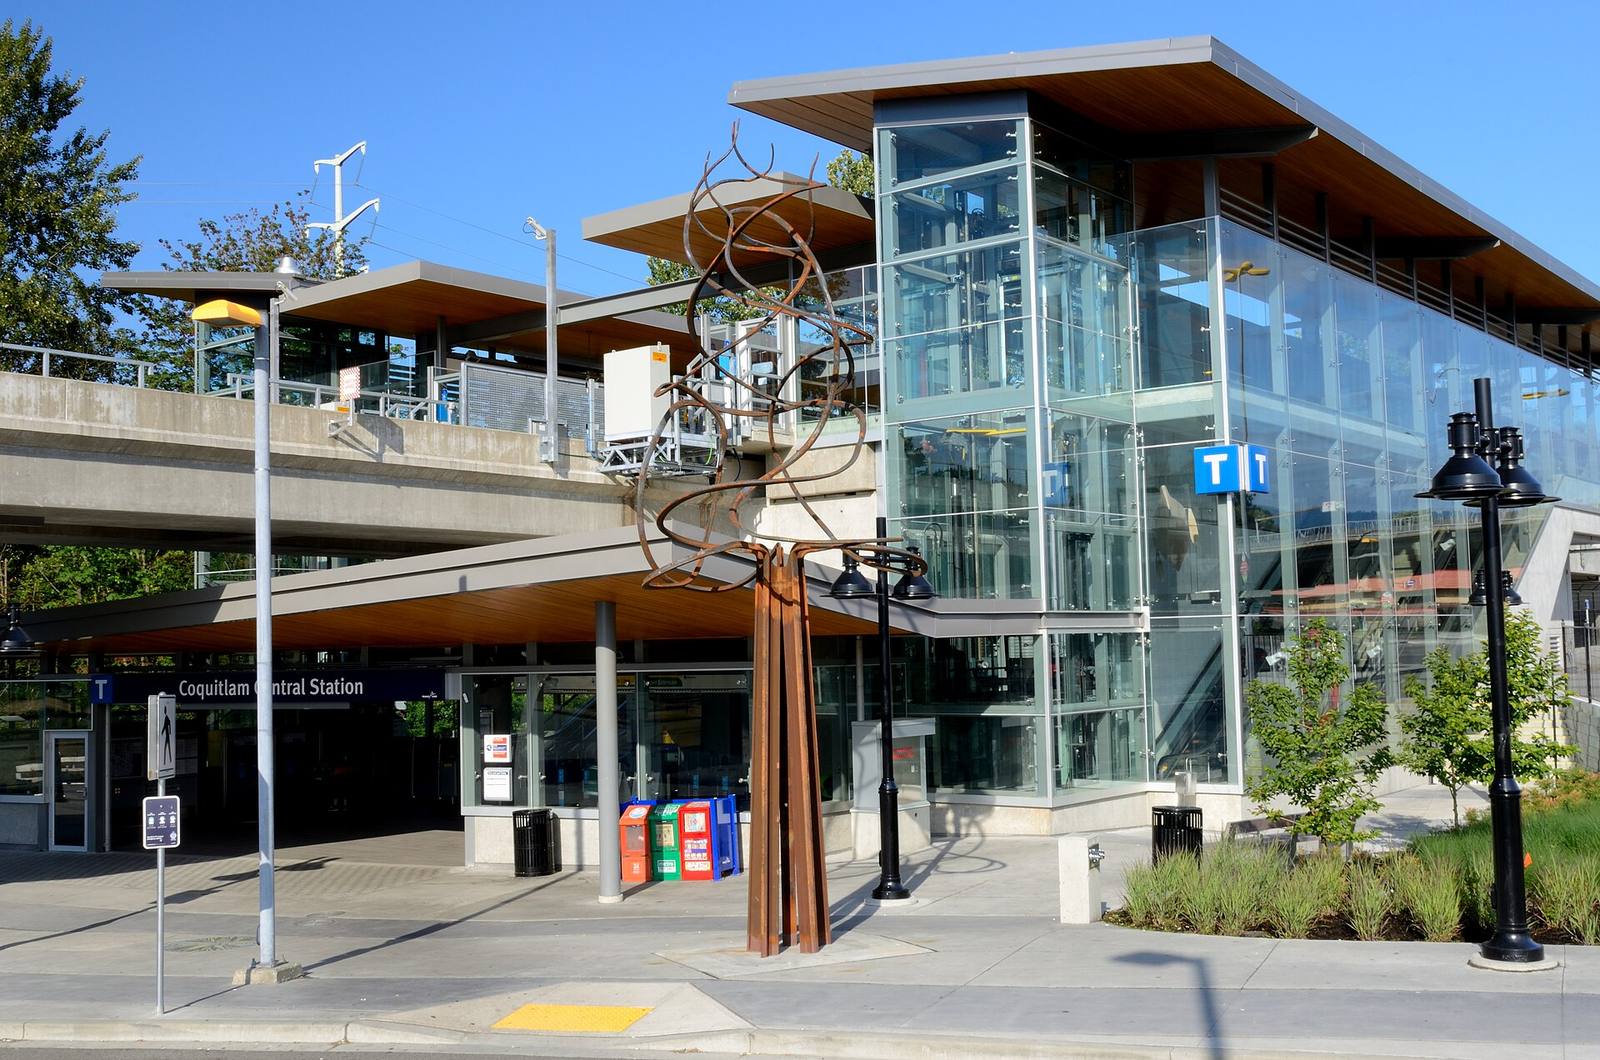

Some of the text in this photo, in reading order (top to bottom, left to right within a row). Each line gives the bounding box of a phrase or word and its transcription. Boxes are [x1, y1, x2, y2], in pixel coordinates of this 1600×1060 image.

[1203, 453, 1228, 485] T
[1255, 453, 1267, 484] T
[95, 679, 108, 700] T
[178, 677, 364, 700] Coquitlam ntral Station
